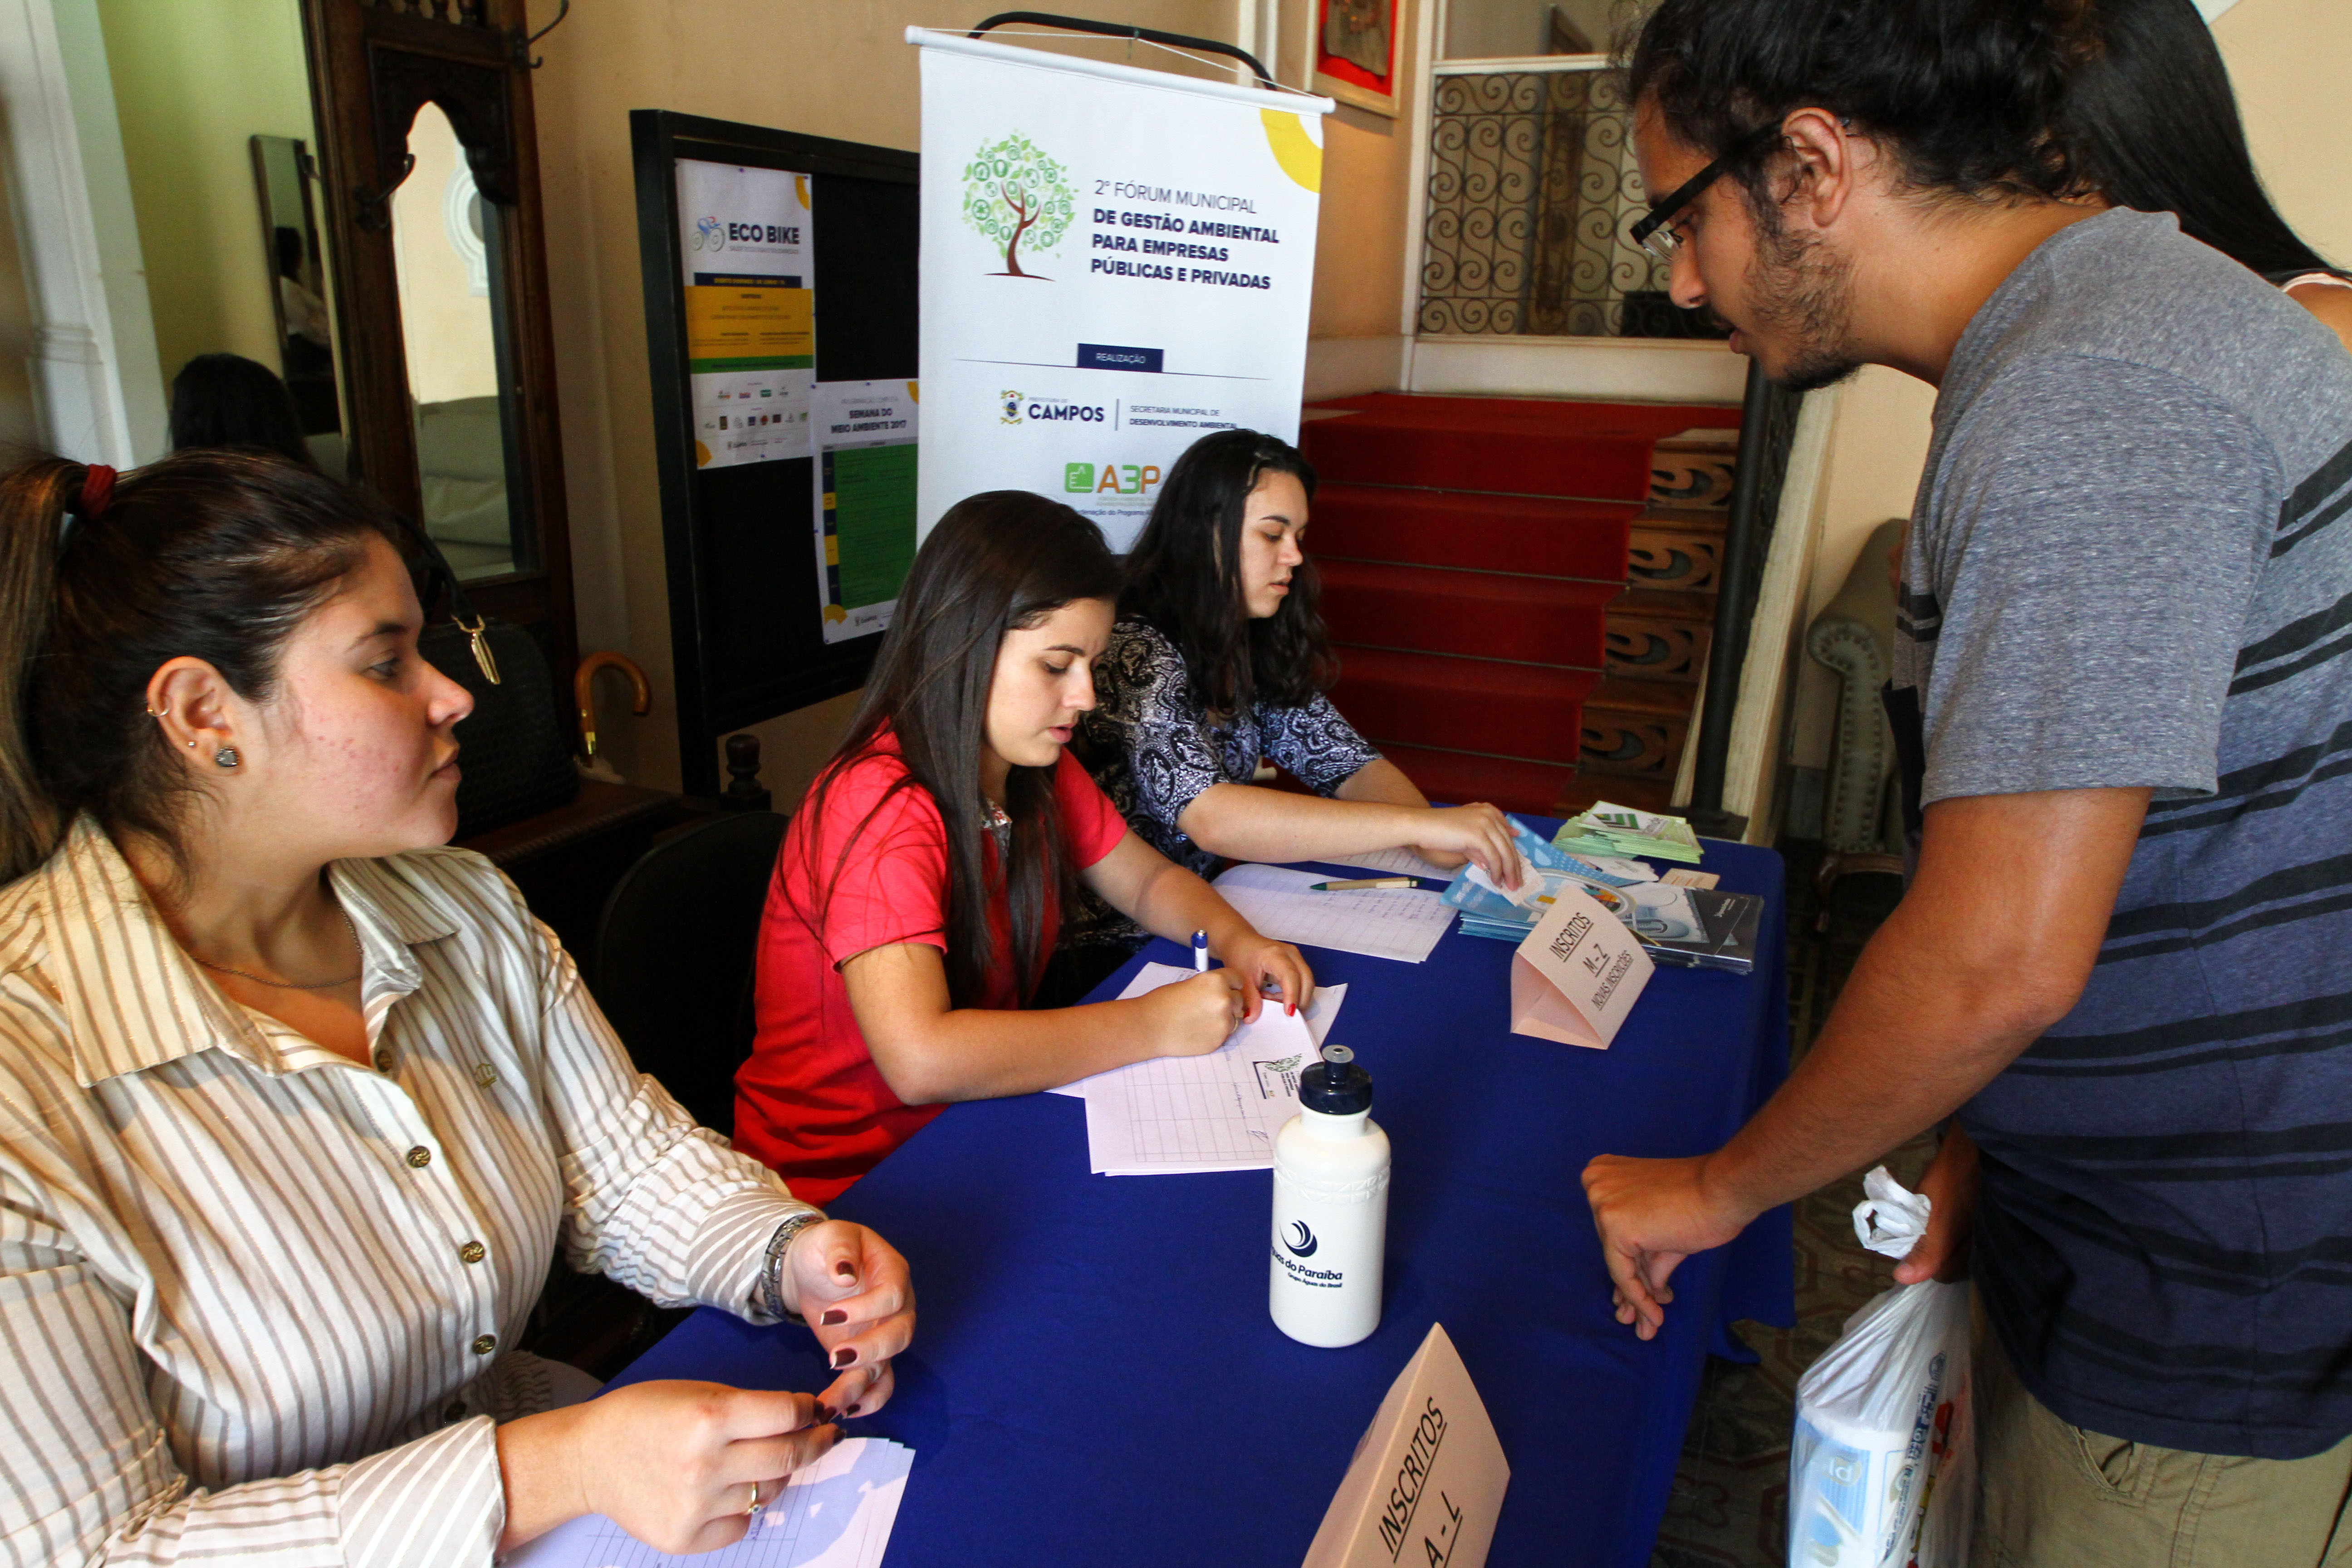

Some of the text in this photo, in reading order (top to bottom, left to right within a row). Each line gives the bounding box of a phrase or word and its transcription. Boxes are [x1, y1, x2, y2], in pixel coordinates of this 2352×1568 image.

[1114, 180, 1171, 203] FÓRUM
[1176, 190, 1257, 214] MUNICIPAL
[729, 223, 799, 244] ECO BIKE
[1093, 208, 1279, 243] DE GESTÃO AMBIENTAL
[1092, 234, 1228, 261] PARA EMPRESAS
[1092, 256, 1271, 289] PÚBLICAS E PRIVADAS
[1096, 353, 1146, 364] REALIZAÇÃO
[850, 409, 879, 418] SEMANA
[1029, 404, 1104, 422] CAMPOS
[1130, 406, 1170, 414] SECRETARIA
[1173, 408, 1208, 416] MUNICIPAL
[1130, 418, 1197, 427] DESENVOLVIMENTO
[831, 425, 851, 433] MEIO
[853, 421, 888, 431] AMBIENTE
[1097, 465, 1160, 494] A3P
[1549, 912, 1591, 960] INSCRITOS
[1583, 957, 1598, 974] M
[1593, 944, 1607, 959] Z
[1591, 982, 1610, 1008] NOVAS
[1285, 1259, 1297, 1271] do
[1298, 1264, 1343, 1280] Paraíba
[1288, 1272, 1301, 1282] Grupo
[1378, 1396, 1444, 1555] INSCRITOS
[1425, 1537, 1444, 1568] A
[1441, 1490, 1460, 1524] L
